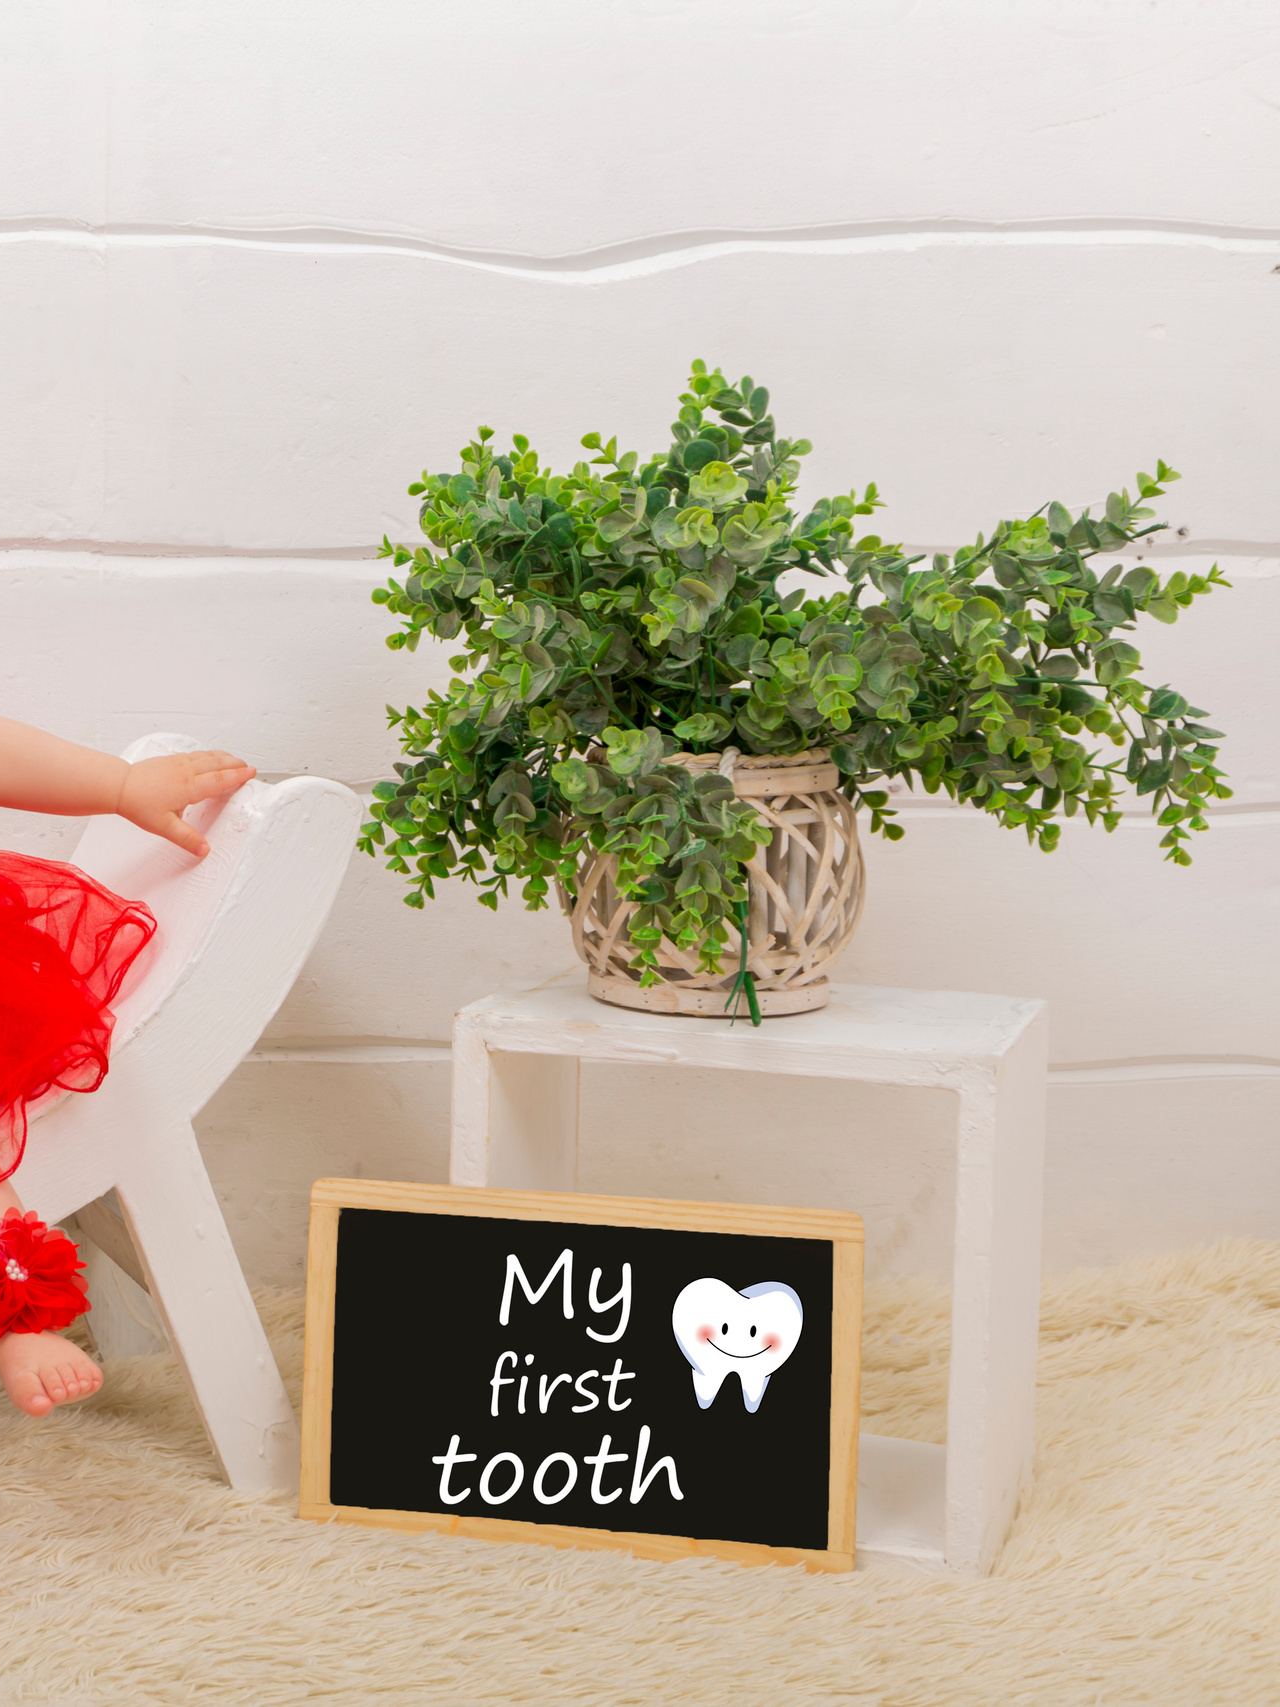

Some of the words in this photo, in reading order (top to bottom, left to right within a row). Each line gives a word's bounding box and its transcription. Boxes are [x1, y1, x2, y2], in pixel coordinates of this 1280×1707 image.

[498, 1248, 632, 1344] My
[489, 1350, 636, 1417] first
[431, 1424, 685, 1505] tooth
